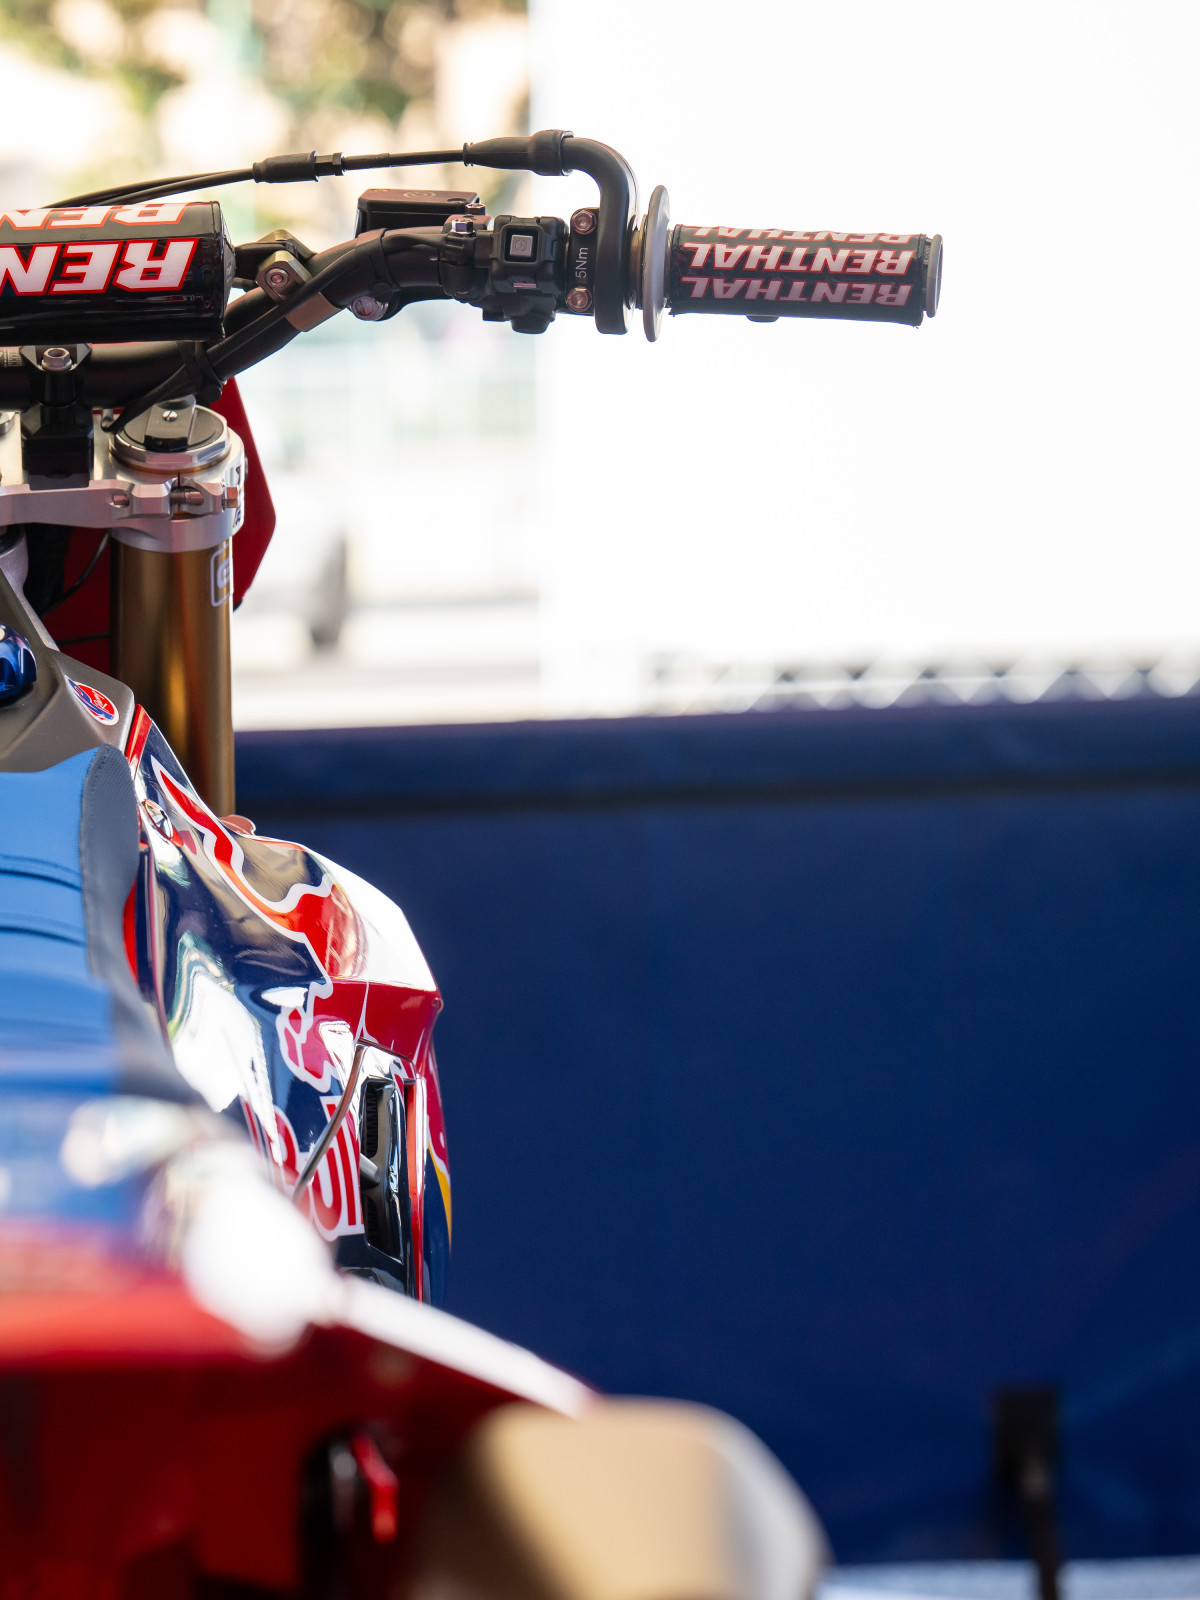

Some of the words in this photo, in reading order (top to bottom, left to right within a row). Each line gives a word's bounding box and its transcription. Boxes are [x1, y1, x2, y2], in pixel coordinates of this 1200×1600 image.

[575, 247, 588, 278] 5Nm
[681, 242, 914, 276] RENTHAL
[681, 276, 913, 306] RENTHAL
